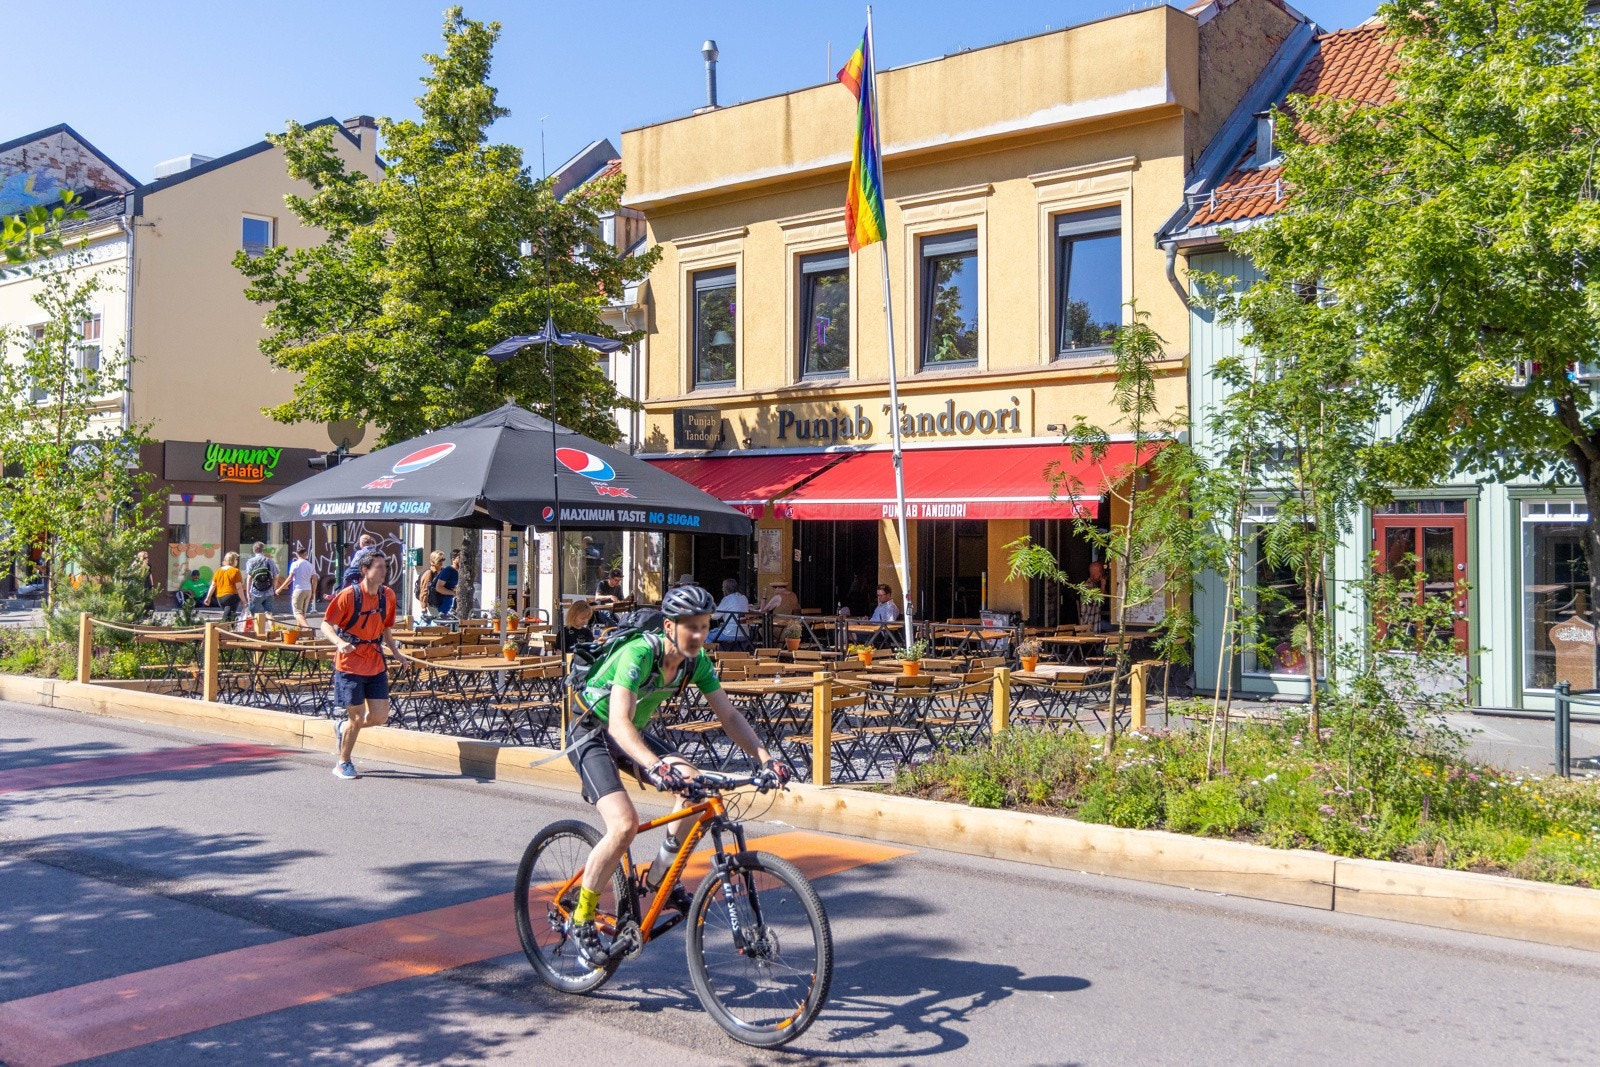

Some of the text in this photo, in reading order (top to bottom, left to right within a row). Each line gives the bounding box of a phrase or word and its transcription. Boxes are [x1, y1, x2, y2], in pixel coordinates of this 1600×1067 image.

[688, 415, 716, 427] Punjab
[776, 395, 1021, 444] Punjab Tandoori
[684, 430, 720, 441] Tandoori
[219, 463, 264, 478] Falafel
[312, 501, 432, 515] MAXIMUM TASTE NO SUGAR
[882, 503, 967, 518] PUNAB TANDOORI
[560, 508, 700, 527] MAXIMUM TASTE NO SUGAR
[727, 902, 739, 931] SWISS
